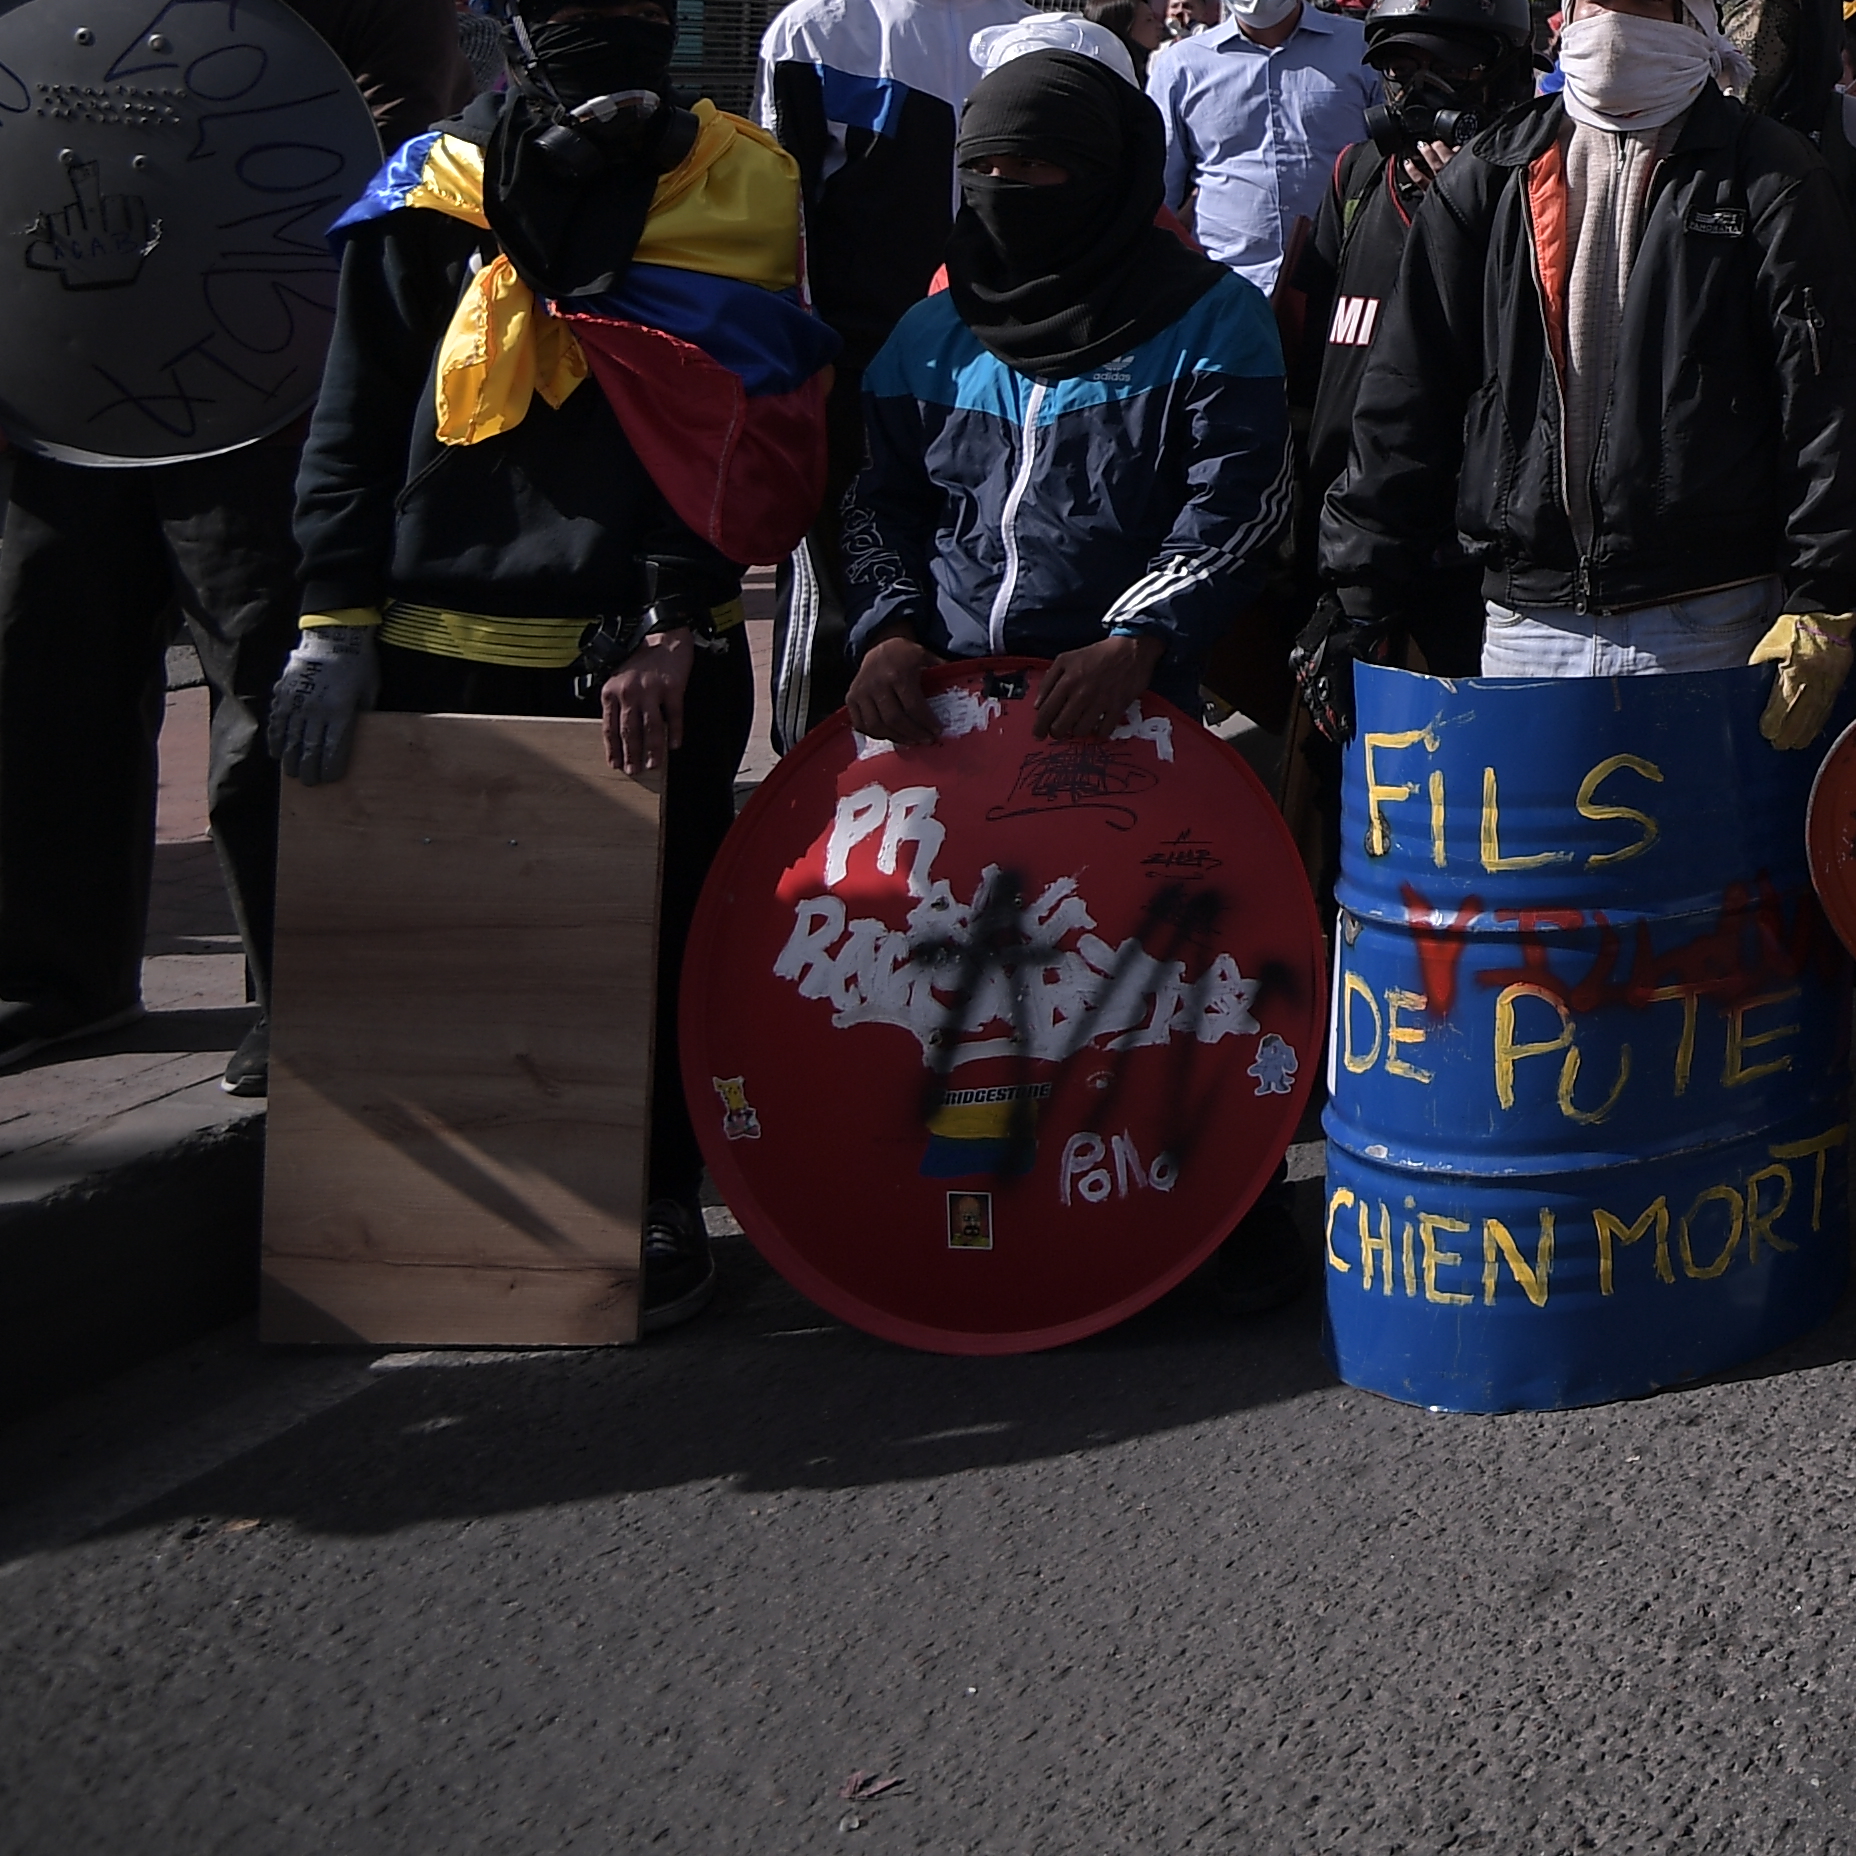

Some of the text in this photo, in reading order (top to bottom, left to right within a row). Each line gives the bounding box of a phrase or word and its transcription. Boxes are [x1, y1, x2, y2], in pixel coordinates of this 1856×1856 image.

[1092, 372, 1132, 383] adidas
[1342, 970, 1436, 1085] DE
[1495, 981, 1801, 1125] PUTE
[1593, 1124, 1847, 1296] MORT
